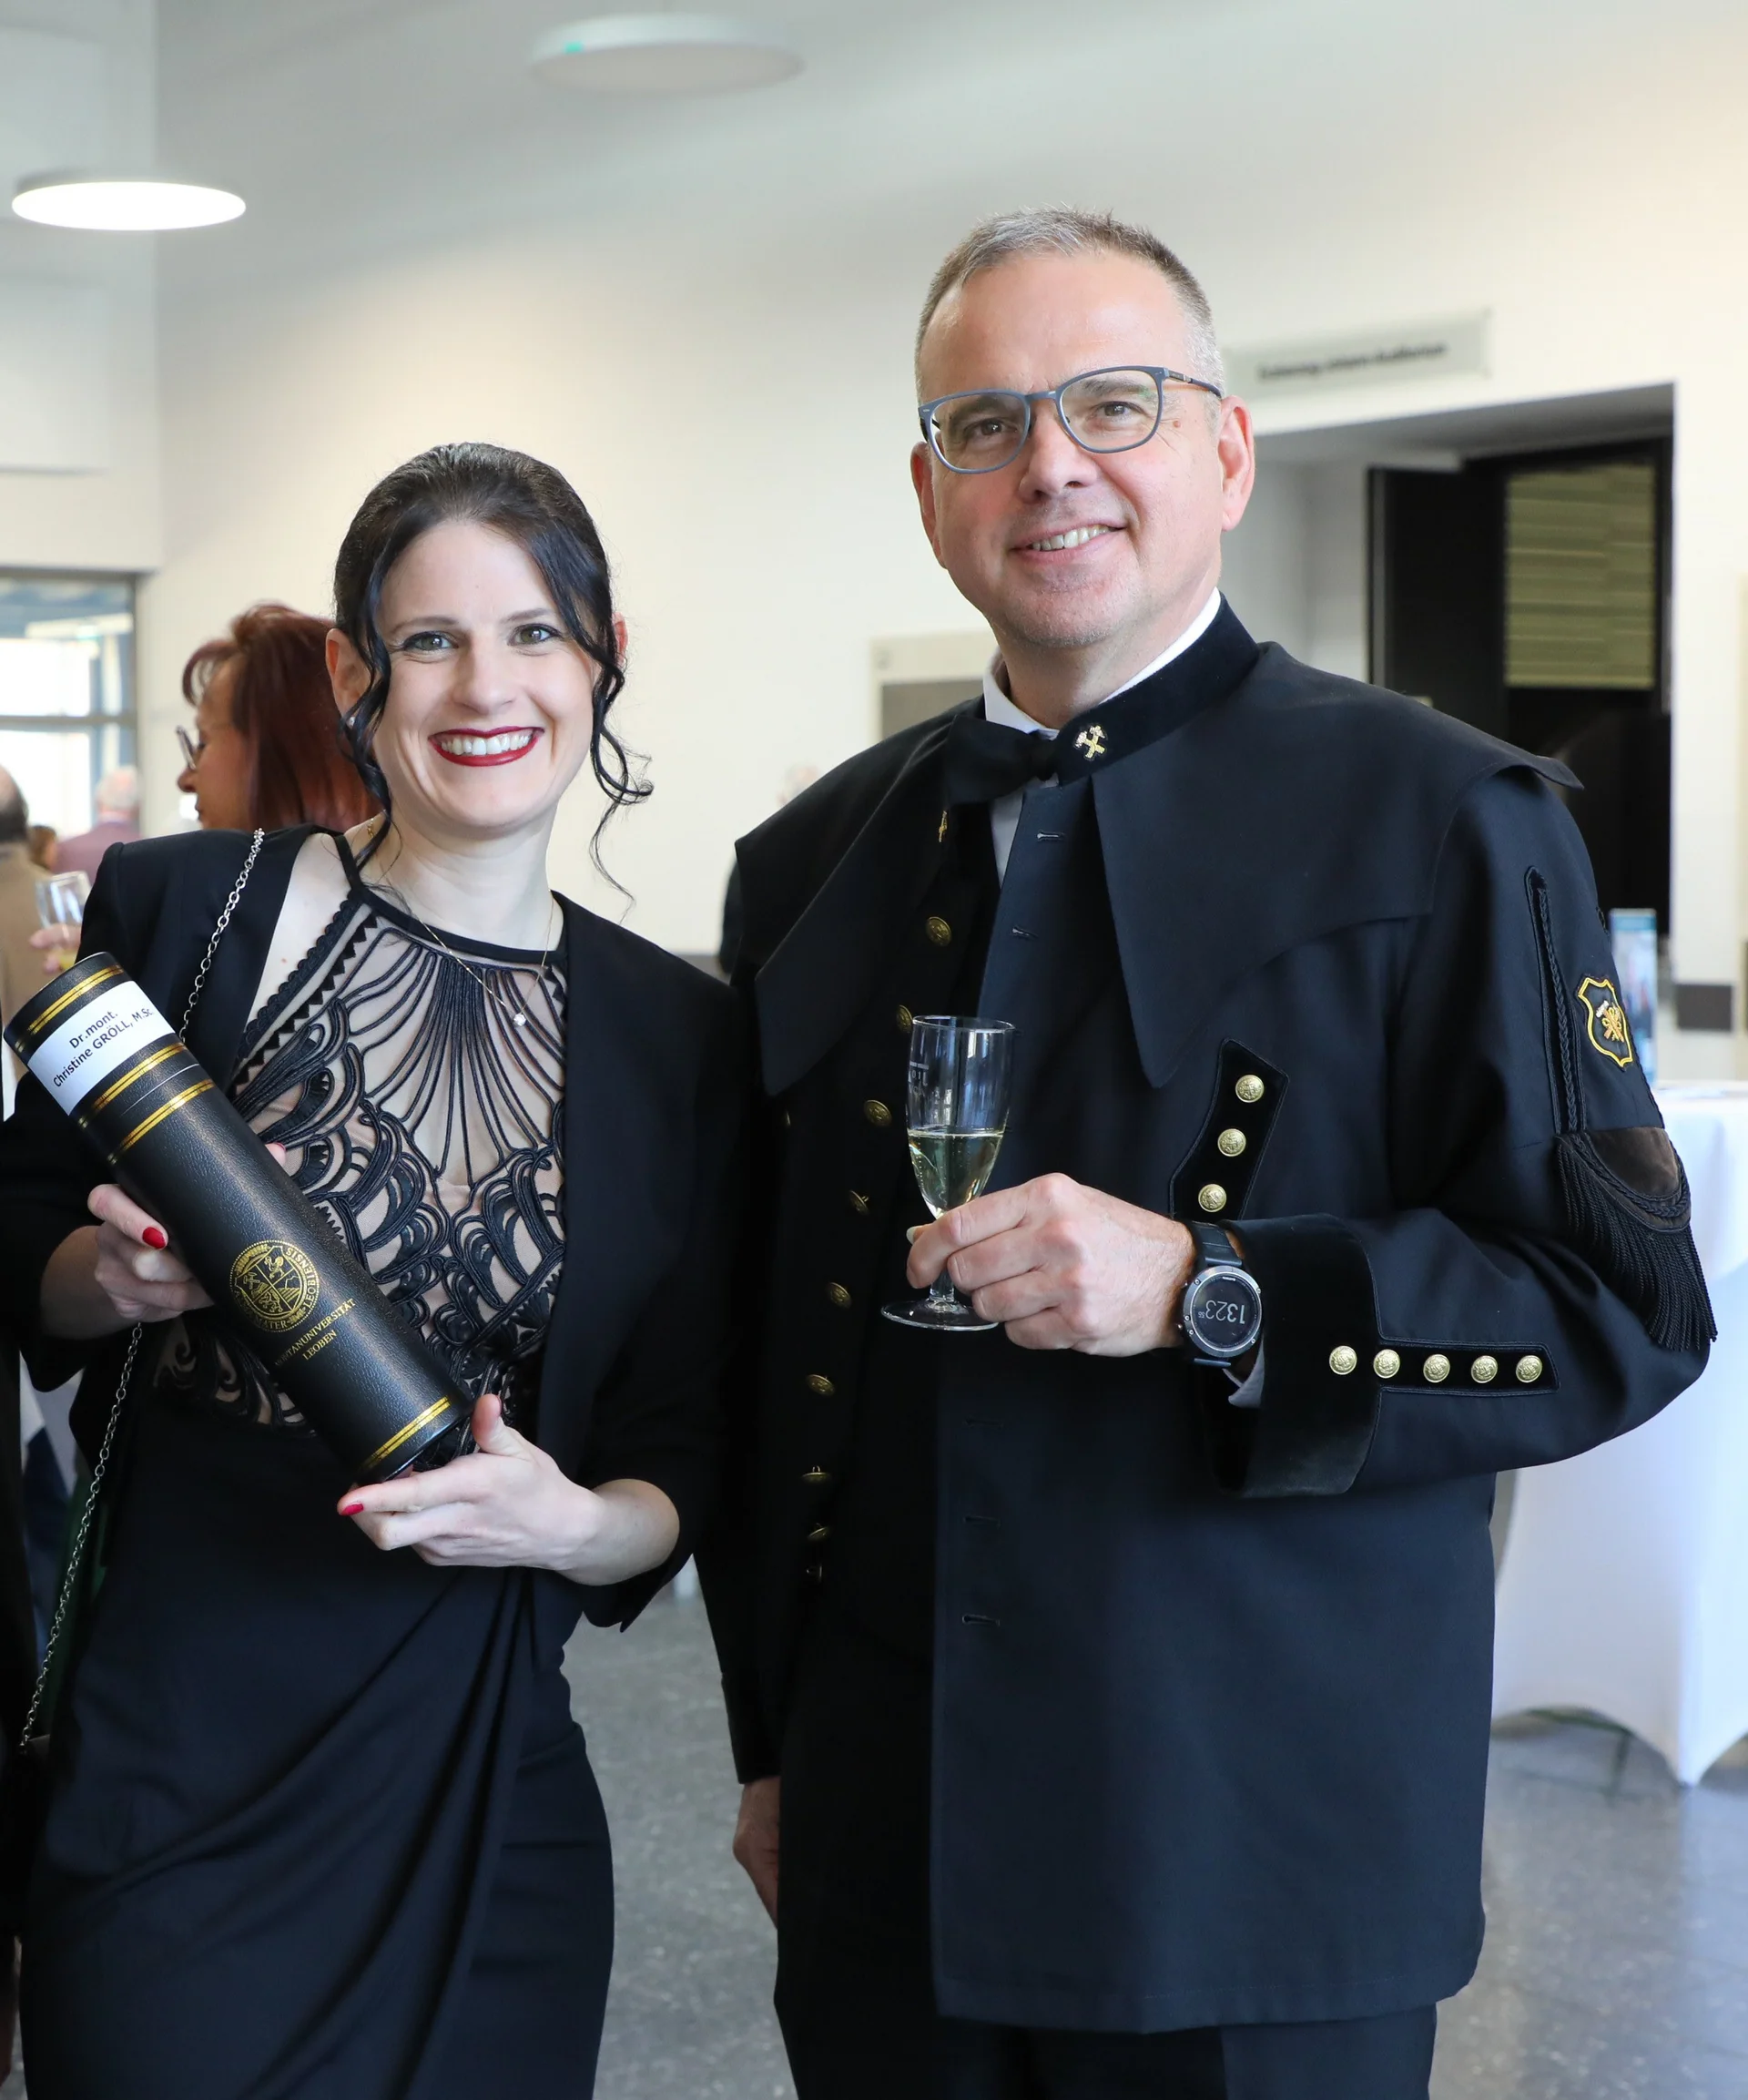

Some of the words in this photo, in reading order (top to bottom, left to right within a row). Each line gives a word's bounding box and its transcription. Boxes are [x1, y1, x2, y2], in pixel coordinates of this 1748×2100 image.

[69, 1011, 118, 1049] Dr.mont.
[53, 1049, 93, 1087] Christine
[92, 1021, 134, 1049] GRÖLL,
[1205, 1300, 1245, 1325] 1323
[302, 1330, 337, 1361] LEOBEN
